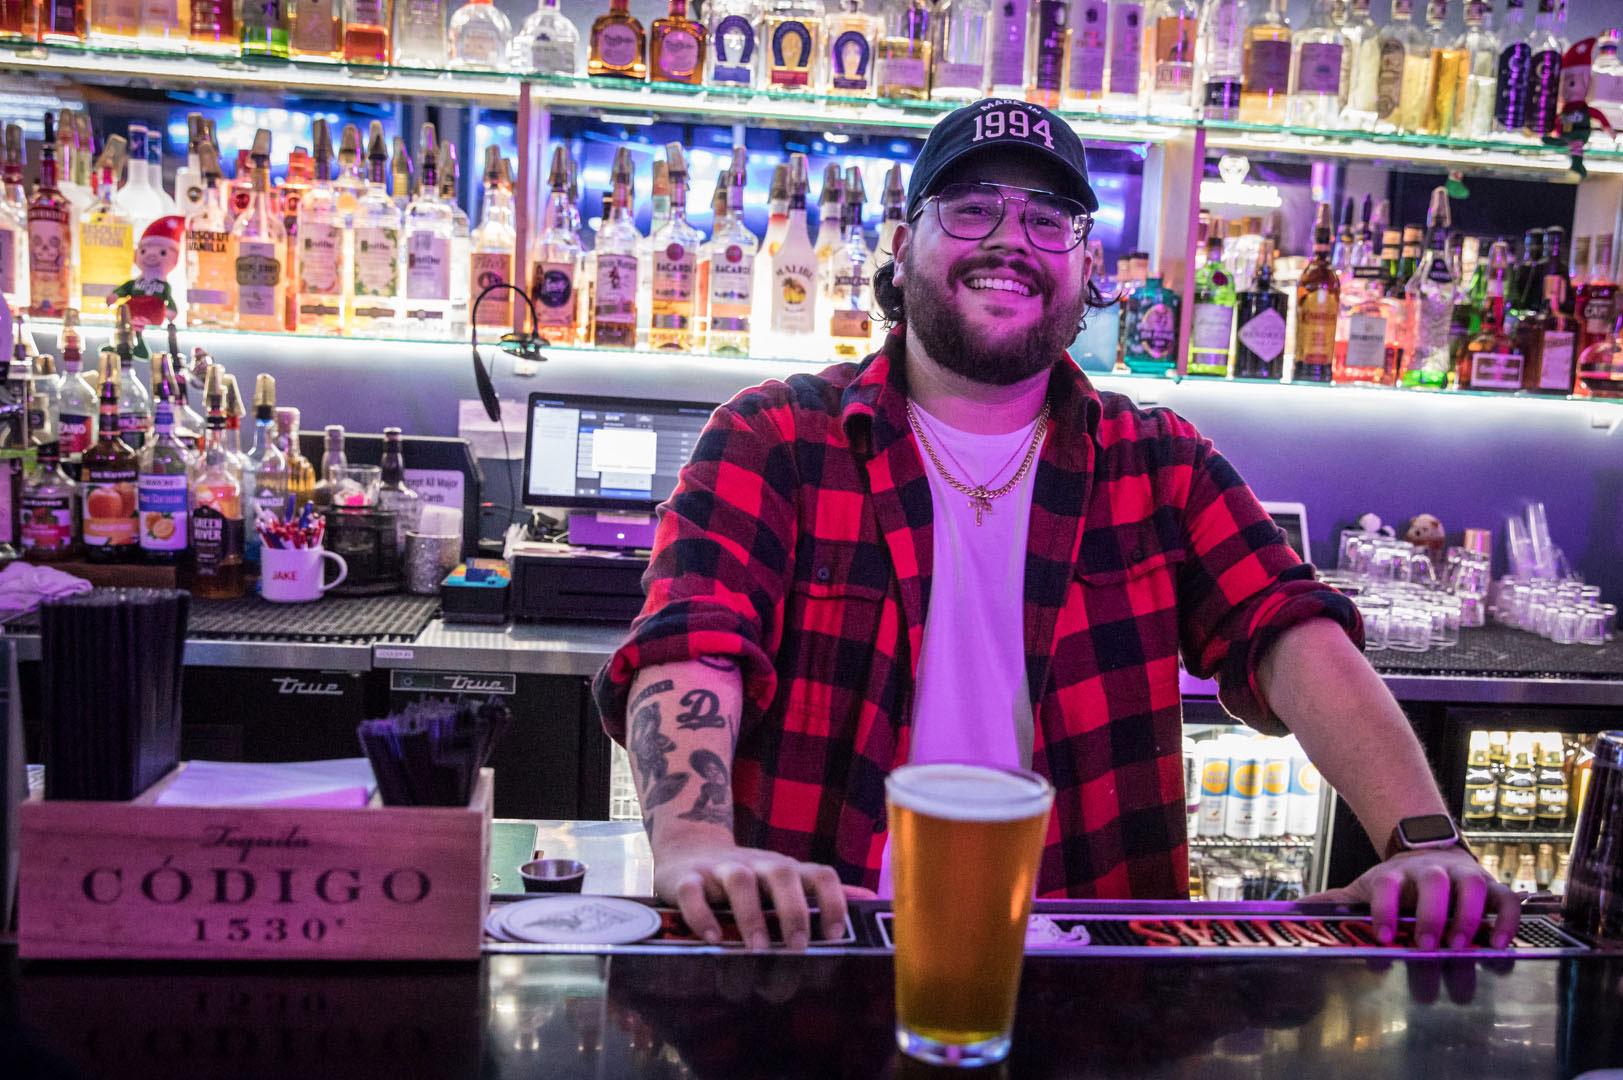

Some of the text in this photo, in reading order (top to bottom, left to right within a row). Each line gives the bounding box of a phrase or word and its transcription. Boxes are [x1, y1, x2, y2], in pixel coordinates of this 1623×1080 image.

[980, 99, 1042, 115] MADE IN
[972, 110, 1055, 150] 1994
[272, 571, 299, 581] JAKE
[202, 823, 310, 863] Tequila
[82, 855, 432, 905] CÓDIGO
